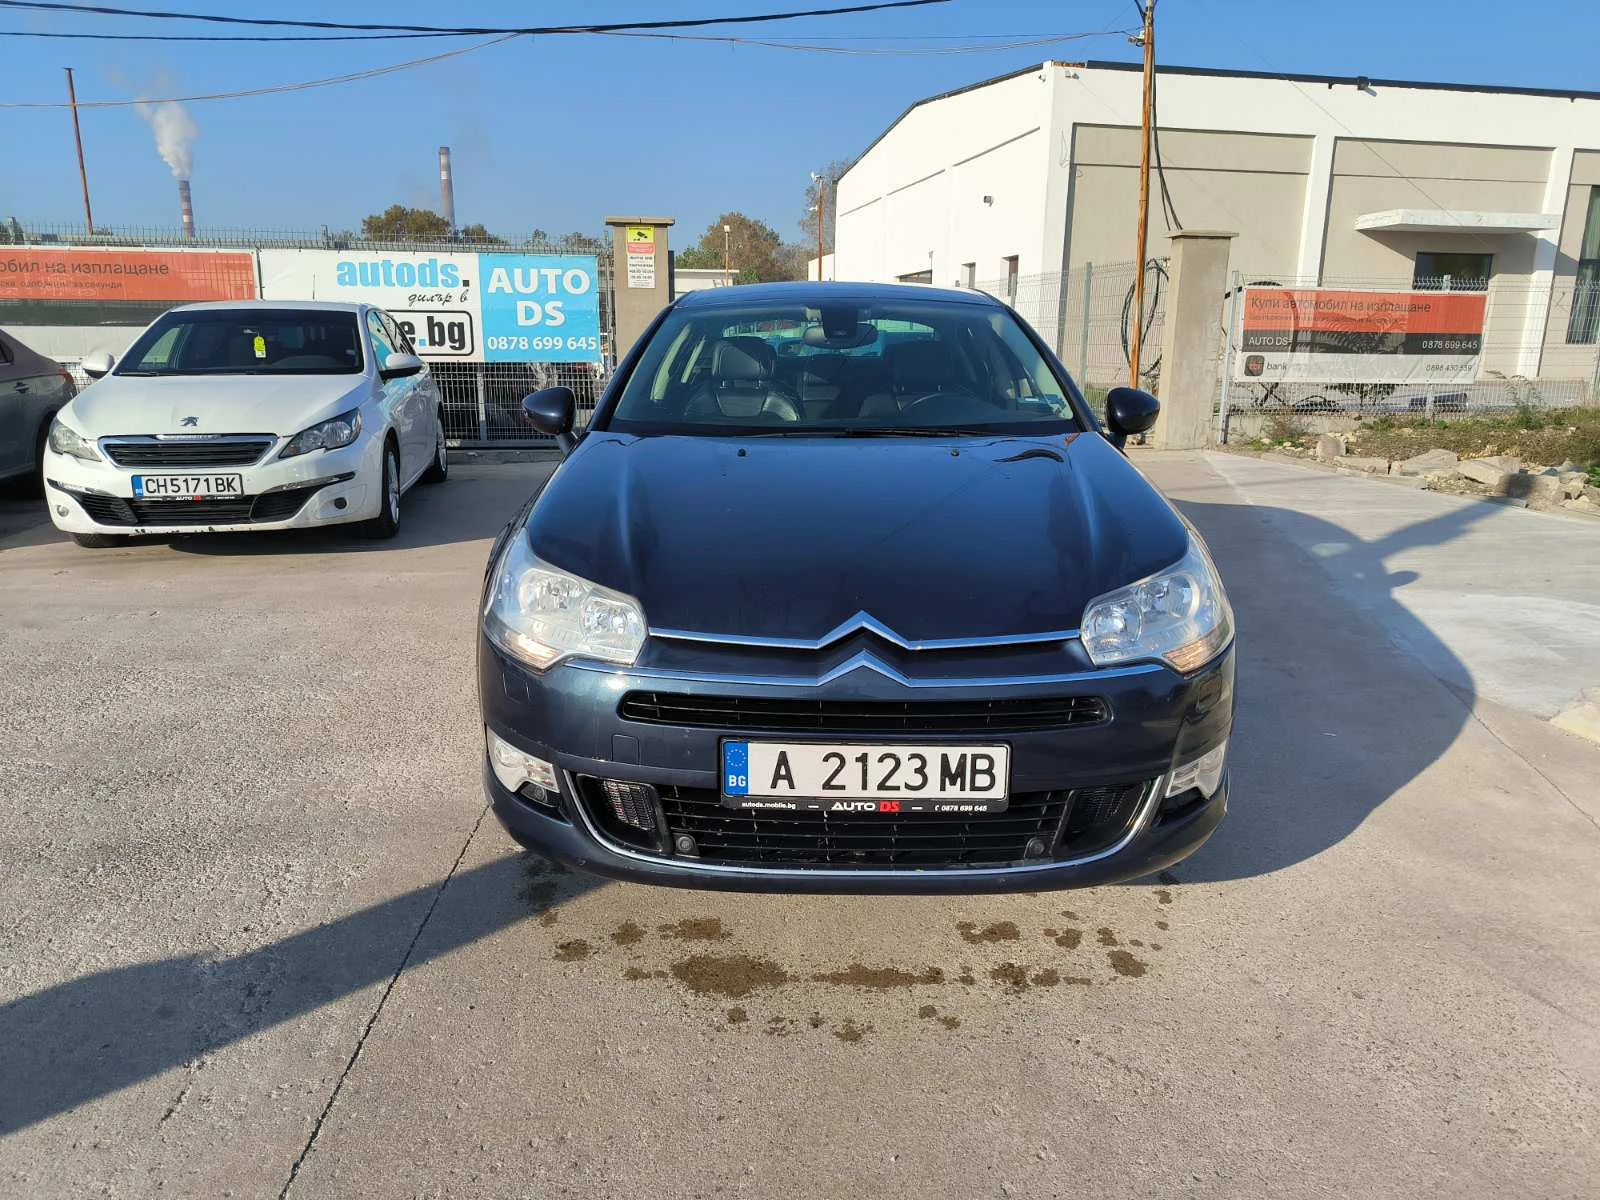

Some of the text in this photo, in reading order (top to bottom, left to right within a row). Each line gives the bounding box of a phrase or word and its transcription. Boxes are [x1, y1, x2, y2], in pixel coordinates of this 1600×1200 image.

[45, 262, 66, 274] на
[71, 262, 169, 276] изплащане
[487, 268, 591, 327] AUTO DS
[1251, 296, 1432, 314] Купи автомобил на изплащане
[487, 336, 598, 351] 0878 699 645
[1248, 336, 1289, 346] AUTO DS
[1422, 340, 1478, 349] 0878 699 645
[1266, 361, 1288, 371] bank
[769, 750, 796, 790] A
[728, 775, 747, 788] BG
[831, 801, 900, 812] AUTO DS
